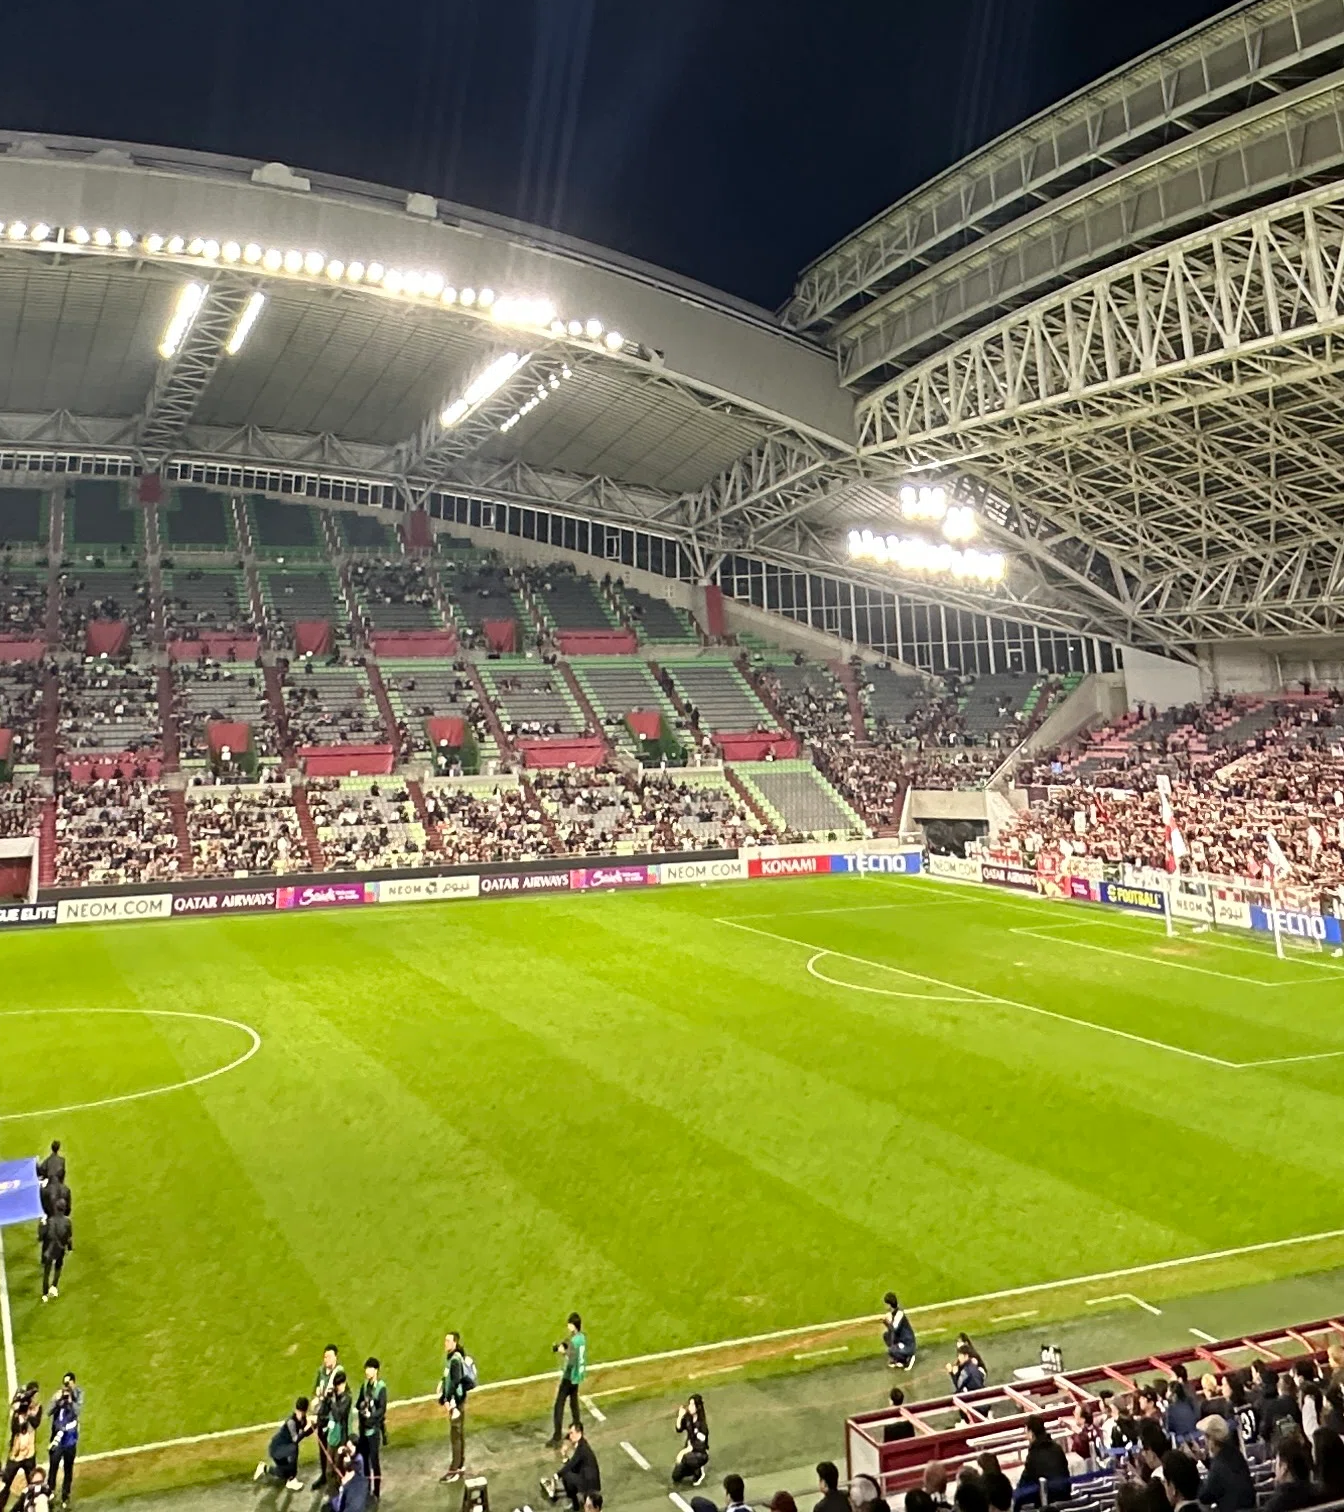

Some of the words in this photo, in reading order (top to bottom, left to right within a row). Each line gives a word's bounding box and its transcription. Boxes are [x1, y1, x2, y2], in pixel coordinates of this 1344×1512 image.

[761, 857, 817, 874] KONAMI
[843, 853, 906, 872] TECNO
[388, 884, 422, 896] NEOM
[481, 877, 520, 892] QATAR
[522, 873, 569, 889] AIRWAYS
[66, 899, 164, 919] NEOM.COM
[173, 896, 218, 912] QATAR
[221, 892, 275, 908] AIRWAYS
[21, 906, 57, 920] ELITE
[1261, 907, 1326, 939] TECNO
